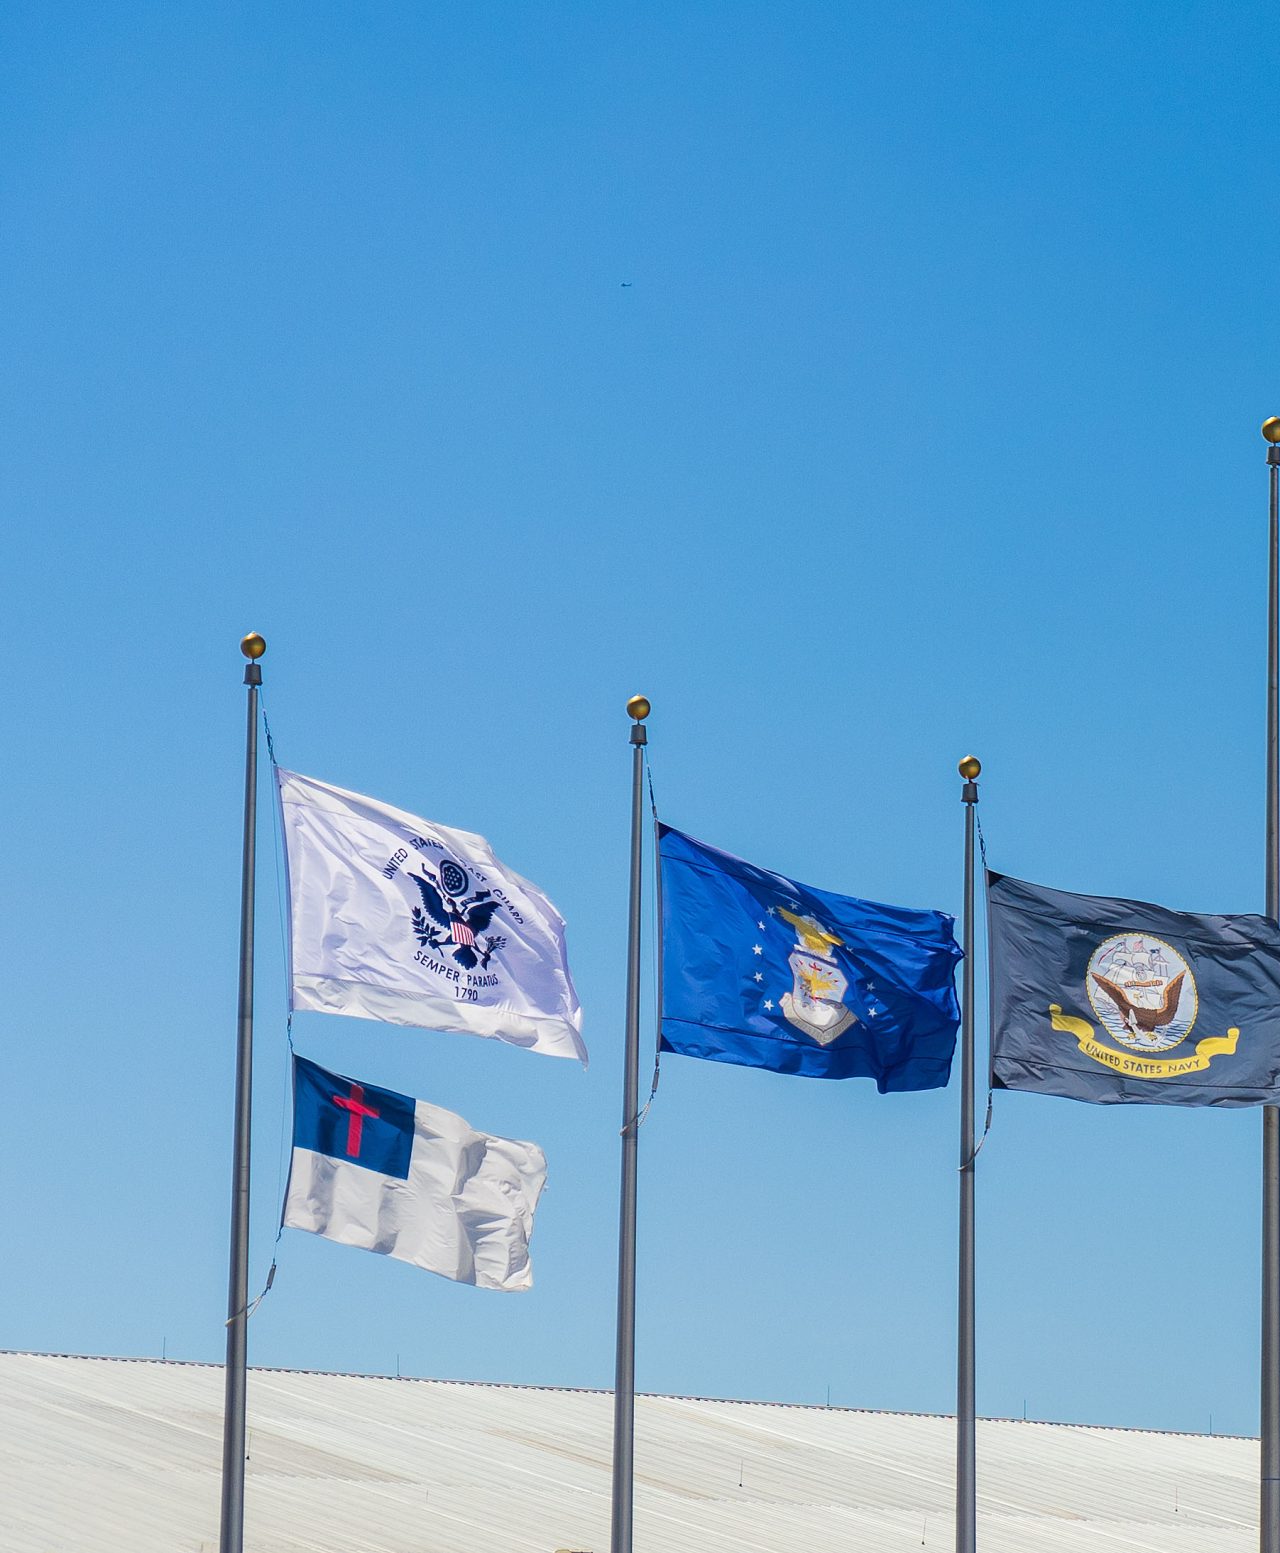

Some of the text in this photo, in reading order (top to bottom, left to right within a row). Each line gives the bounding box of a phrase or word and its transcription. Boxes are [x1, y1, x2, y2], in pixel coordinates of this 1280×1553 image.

[382, 848, 408, 880] UNITED
[409, 837, 444, 850] STATES
[413, 950, 499, 988] SEMPER PARATUS
[455, 986, 478, 1002] 1790
[1085, 1042, 1200, 1074] UNITED STATES NAVY
